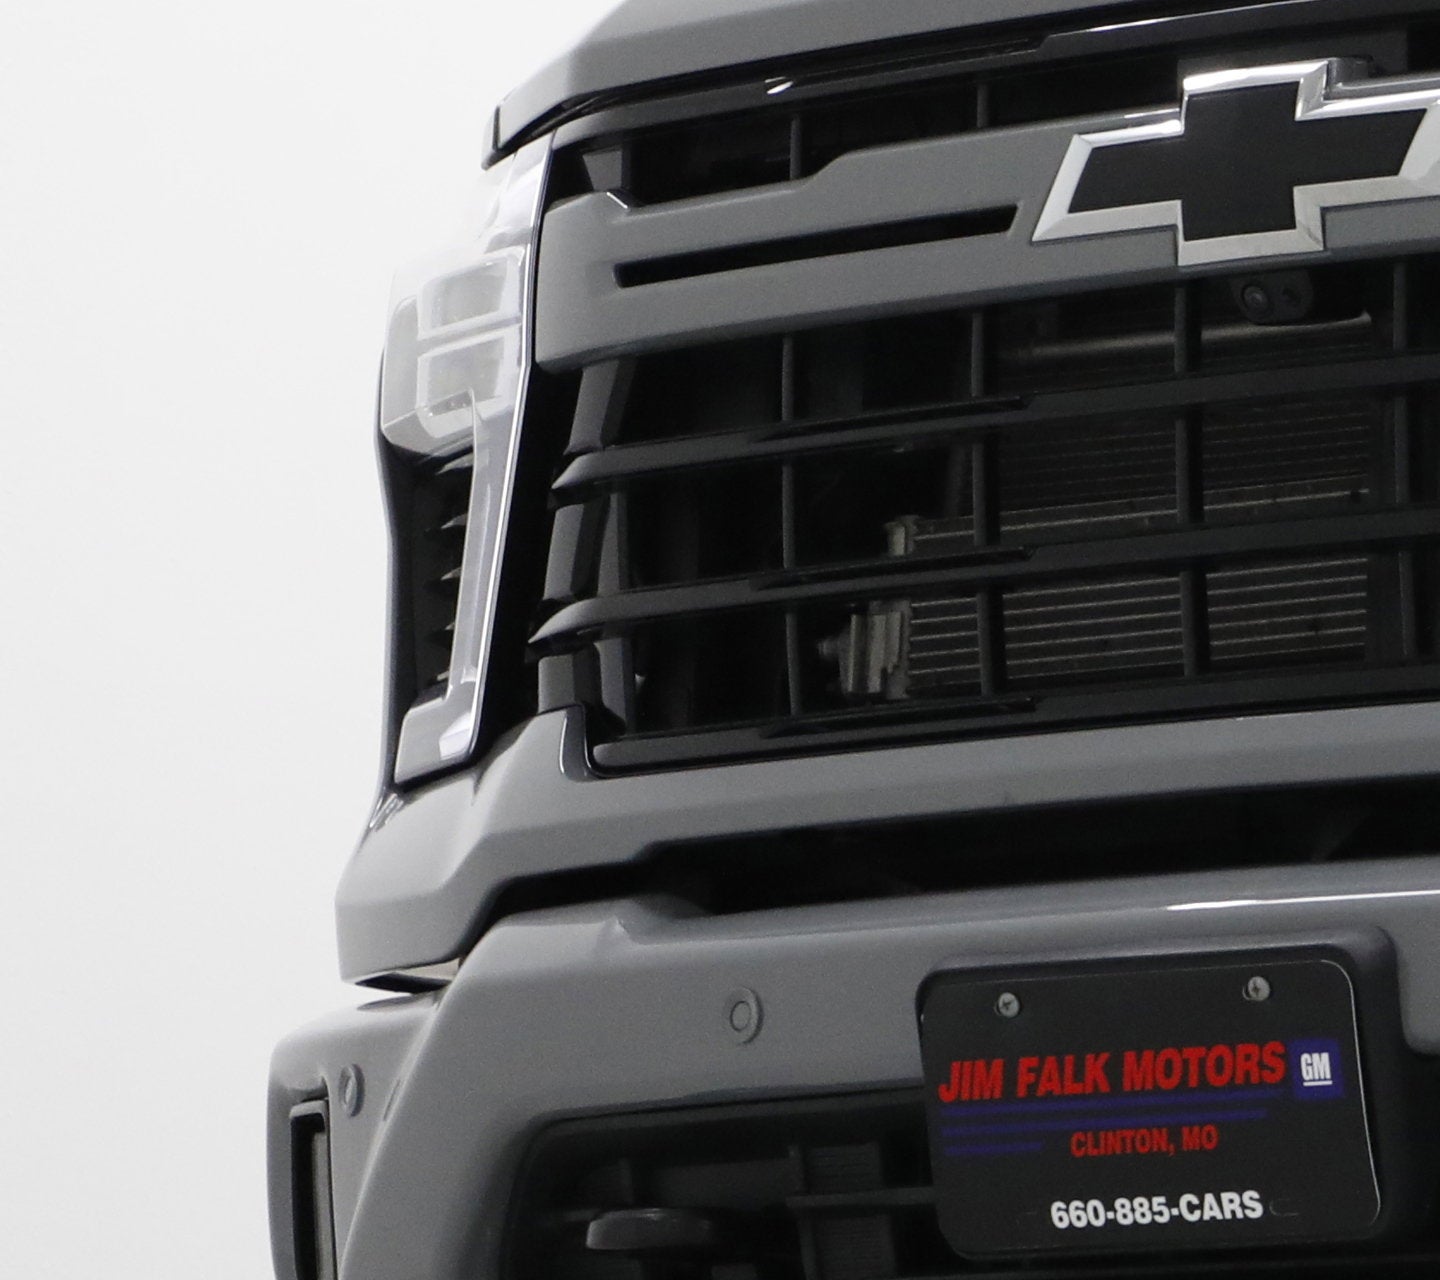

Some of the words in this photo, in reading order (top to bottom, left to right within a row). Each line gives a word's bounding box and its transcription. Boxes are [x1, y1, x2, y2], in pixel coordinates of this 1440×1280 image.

[939, 1060, 1003, 1102] JIM
[1018, 1054, 1111, 1098] FALK
[1123, 1042, 1286, 1093] MOTORS
[1301, 1052, 1332, 1083] GM
[1070, 1128, 1175, 1157] CLINTON,
[1182, 1124, 1219, 1152] MO
[1050, 1190, 1263, 1229] 660-885-CARS
